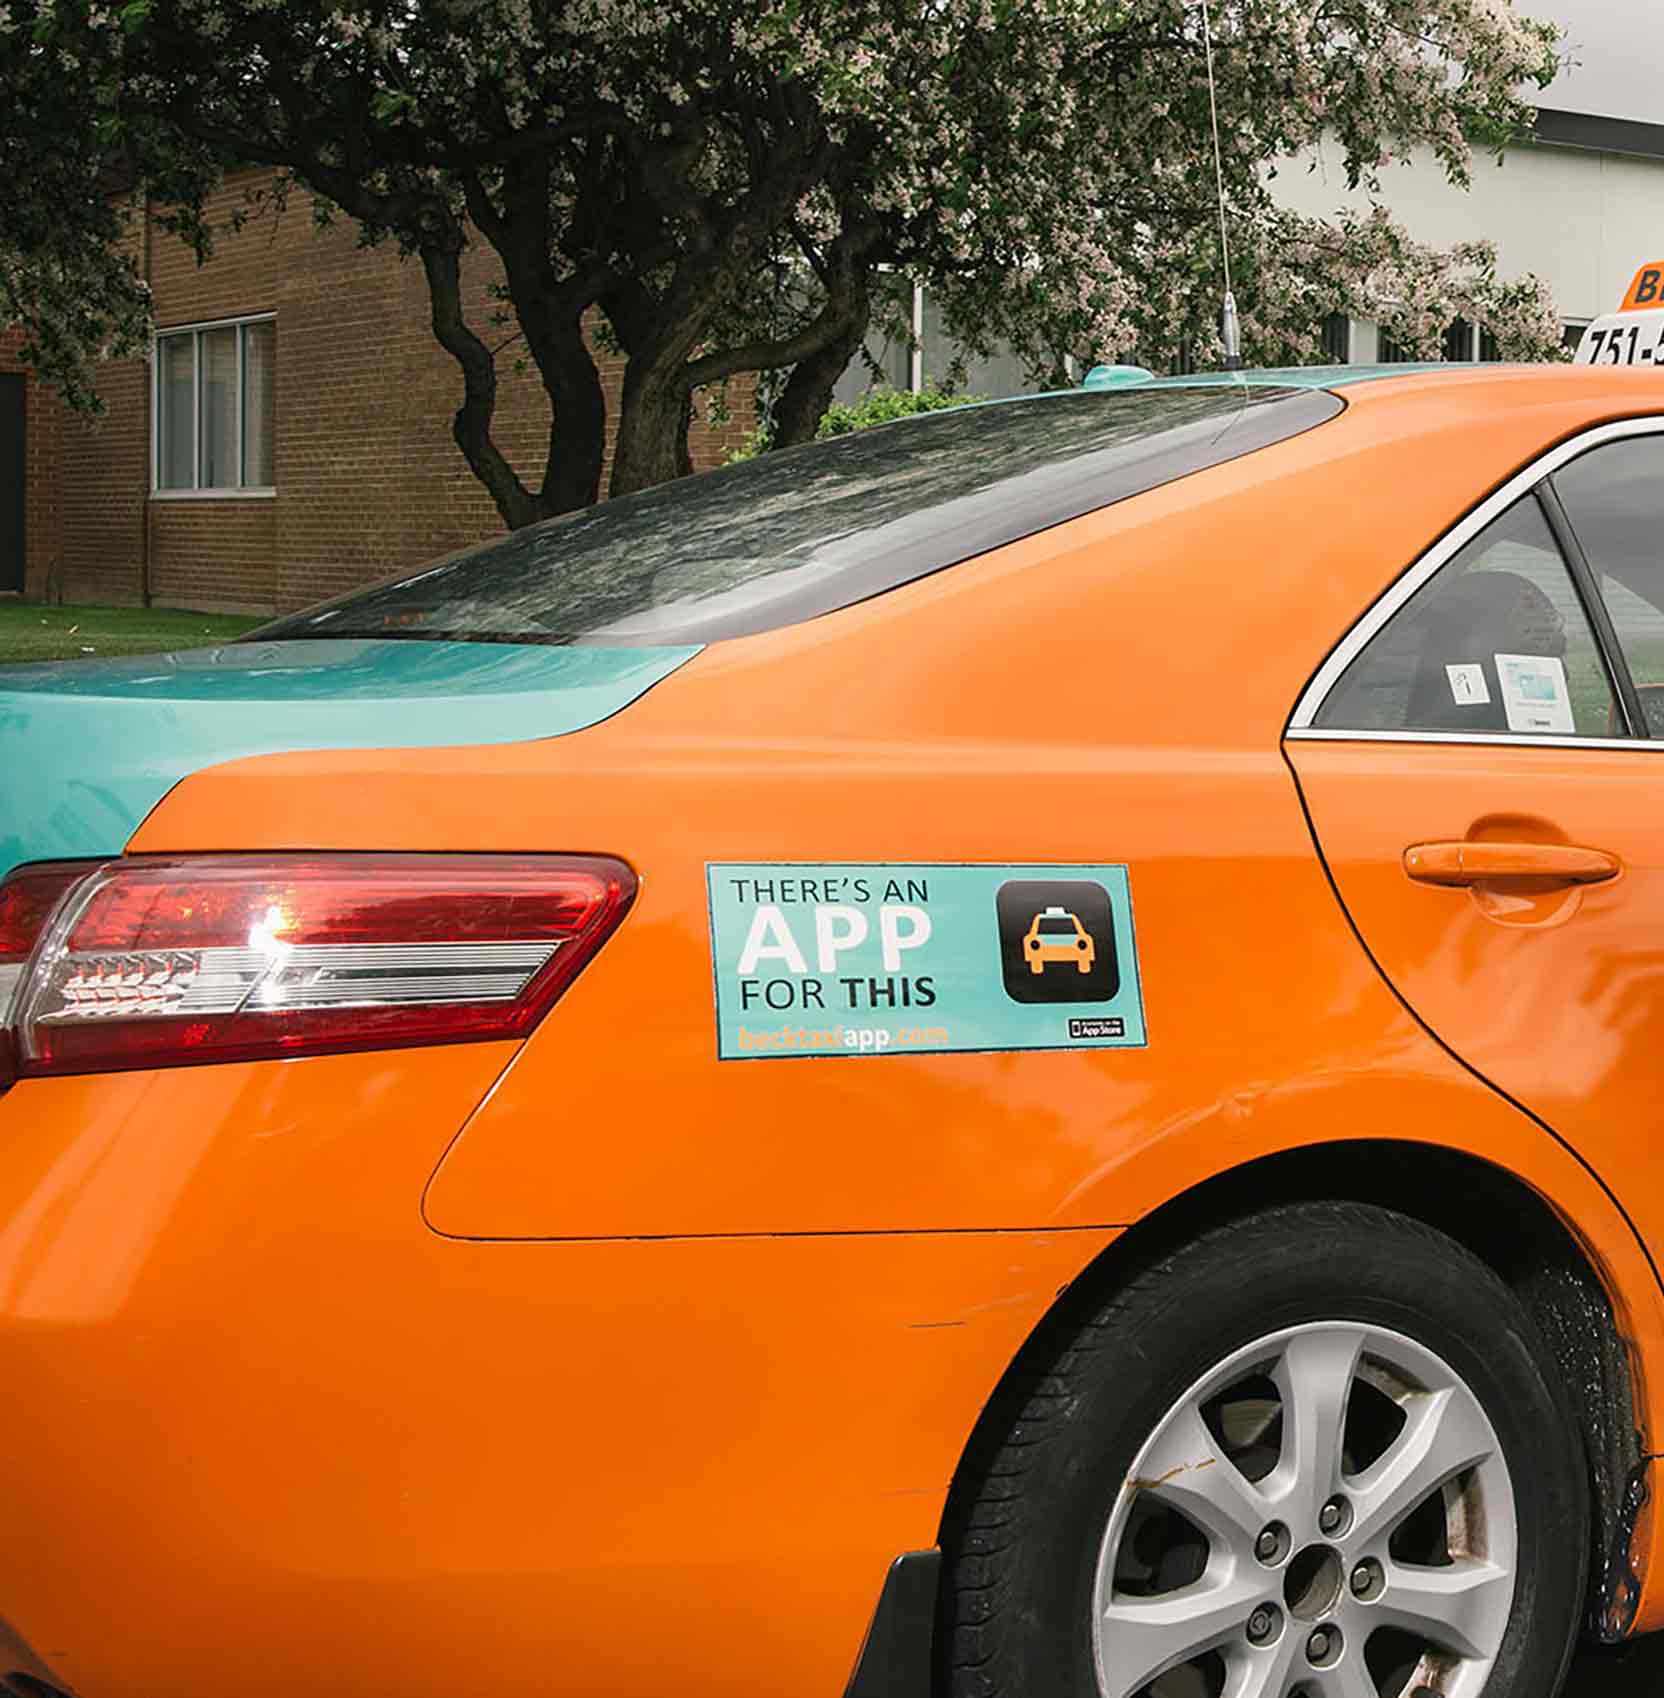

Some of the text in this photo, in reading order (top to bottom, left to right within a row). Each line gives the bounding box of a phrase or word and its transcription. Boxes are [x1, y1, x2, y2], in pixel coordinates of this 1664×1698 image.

[730, 878, 929, 903] THERE'S AN
[737, 905, 933, 974] APP
[740, 976, 937, 1010] FOR THIS
